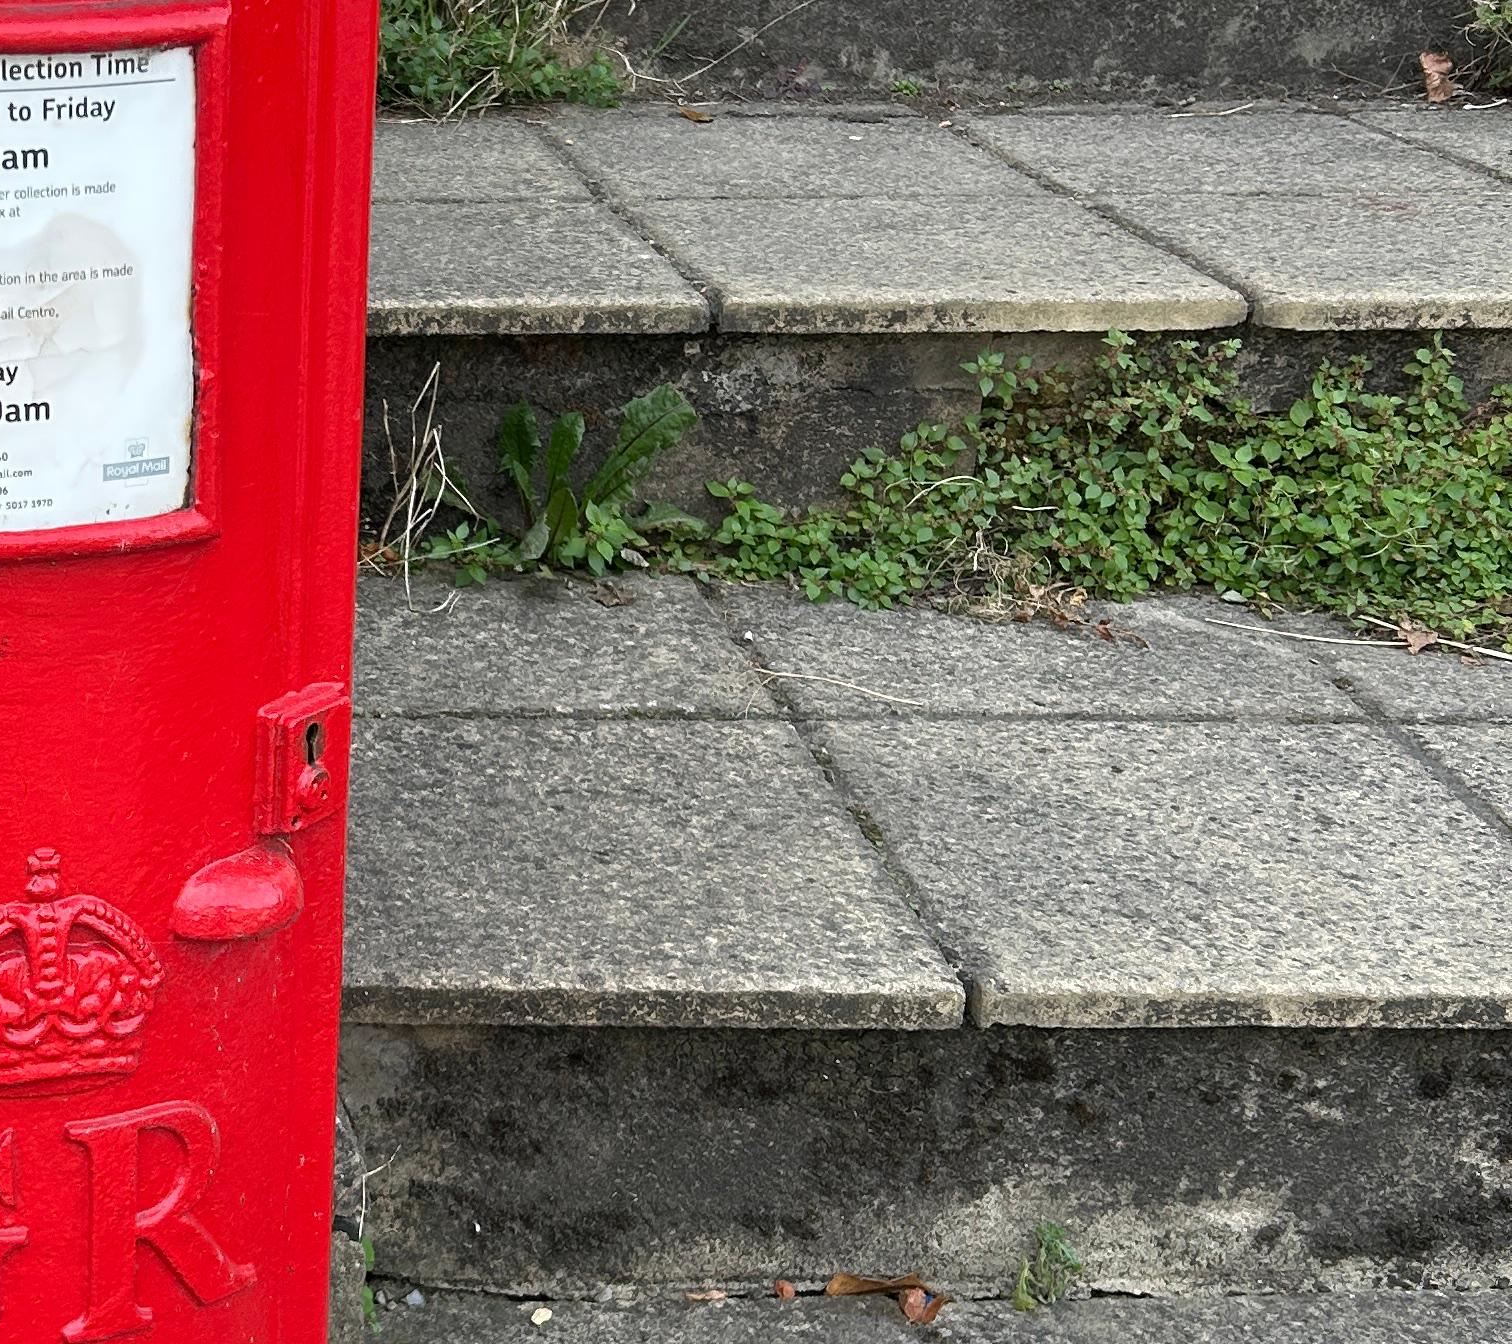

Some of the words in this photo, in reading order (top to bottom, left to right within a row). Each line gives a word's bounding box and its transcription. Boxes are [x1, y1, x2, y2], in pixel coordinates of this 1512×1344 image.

[91, 54, 149, 77] Time
[8, 103, 32, 122] to
[43, 96, 116, 122] Friday
[14, 185, 68, 200] collection
[71, 184, 81, 196] is
[84, 181, 117, 195] made
[8, 206, 21, 218] at
[25, 270, 36, 284] in
[39, 269, 58, 284] the
[61, 269, 87, 282] area
[90, 267, 99, 279] is
[102, 263, 133, 278] made
[106, 463, 140, 477] Royal
[141, 459, 167, 473] Mail
